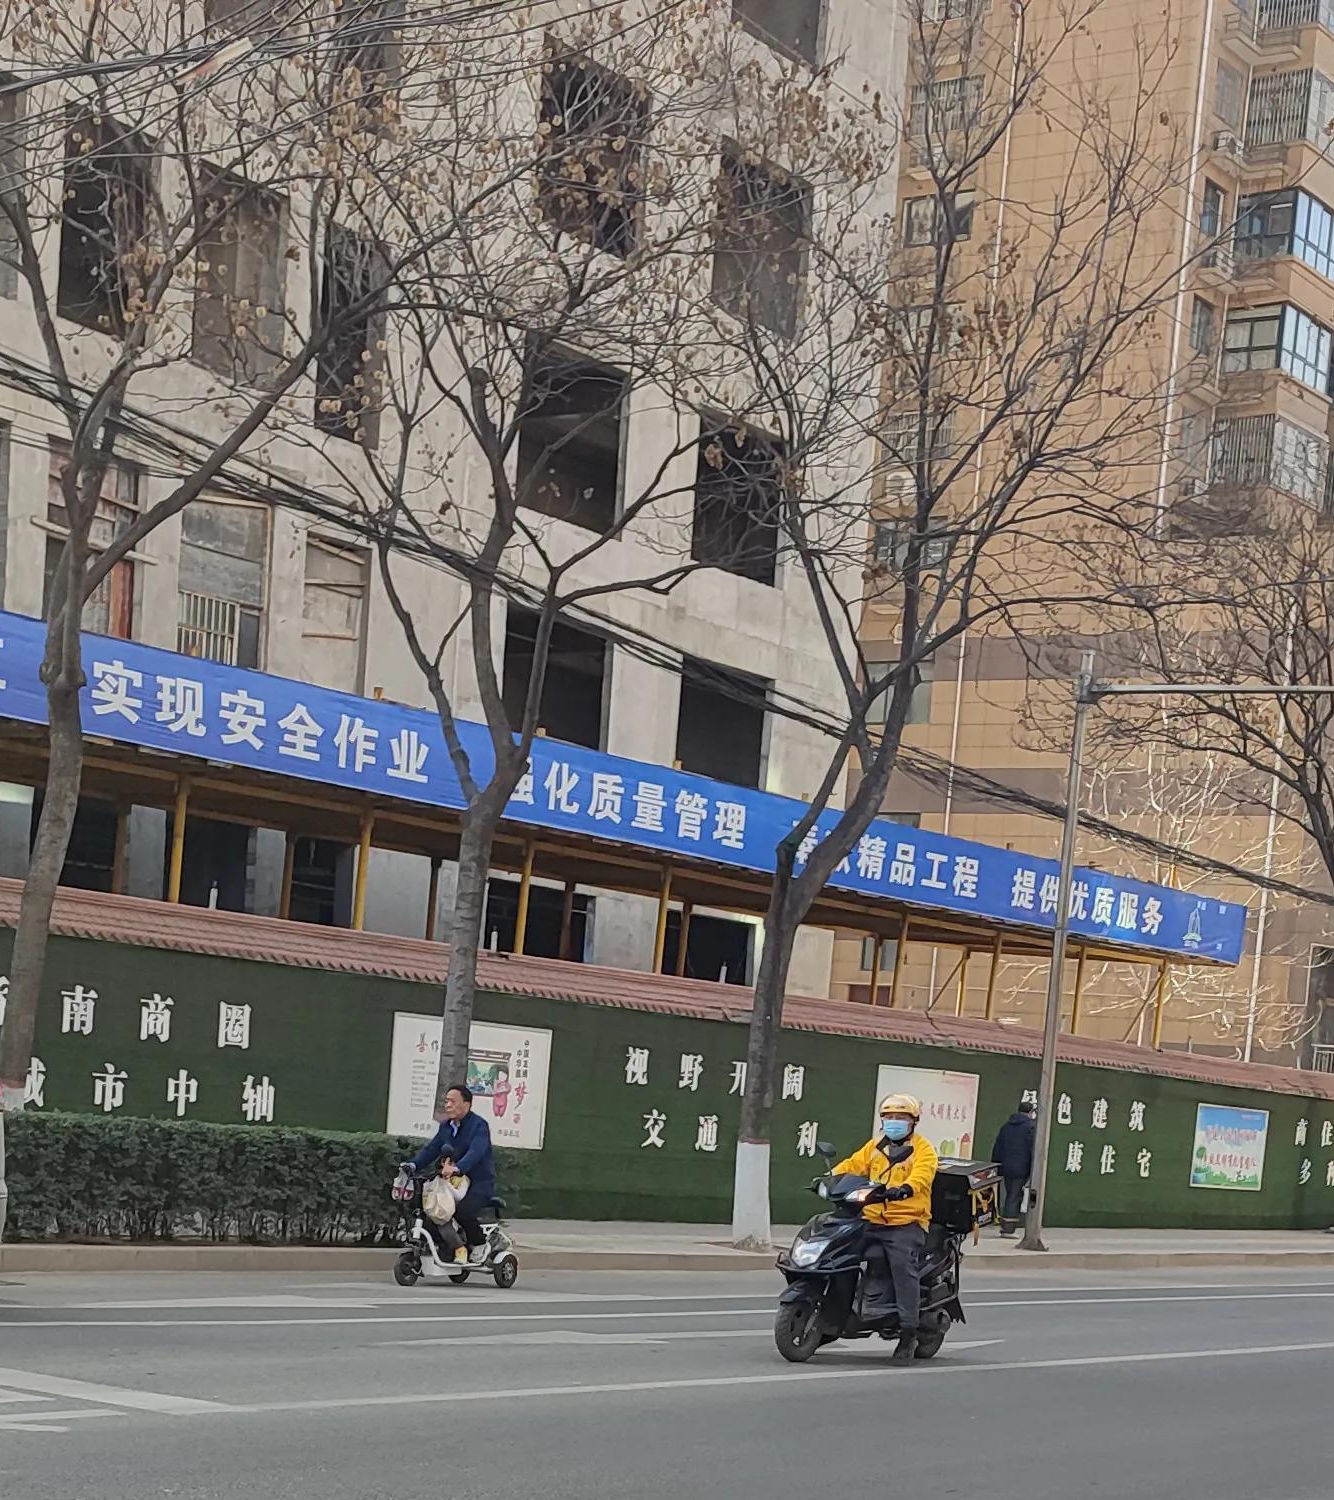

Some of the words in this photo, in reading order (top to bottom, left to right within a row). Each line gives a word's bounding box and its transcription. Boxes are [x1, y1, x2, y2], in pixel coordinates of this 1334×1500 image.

[91, 660, 430, 785] 实现安全作业
[793, 819, 980, 899] 精品工程
[1011, 867, 1164, 936] 提供优质服务
[624, 1046, 805, 1101] 视野开阔
[640, 1108, 820, 1158] 交通利
[1064, 1140, 1153, 1178] 康住宅
